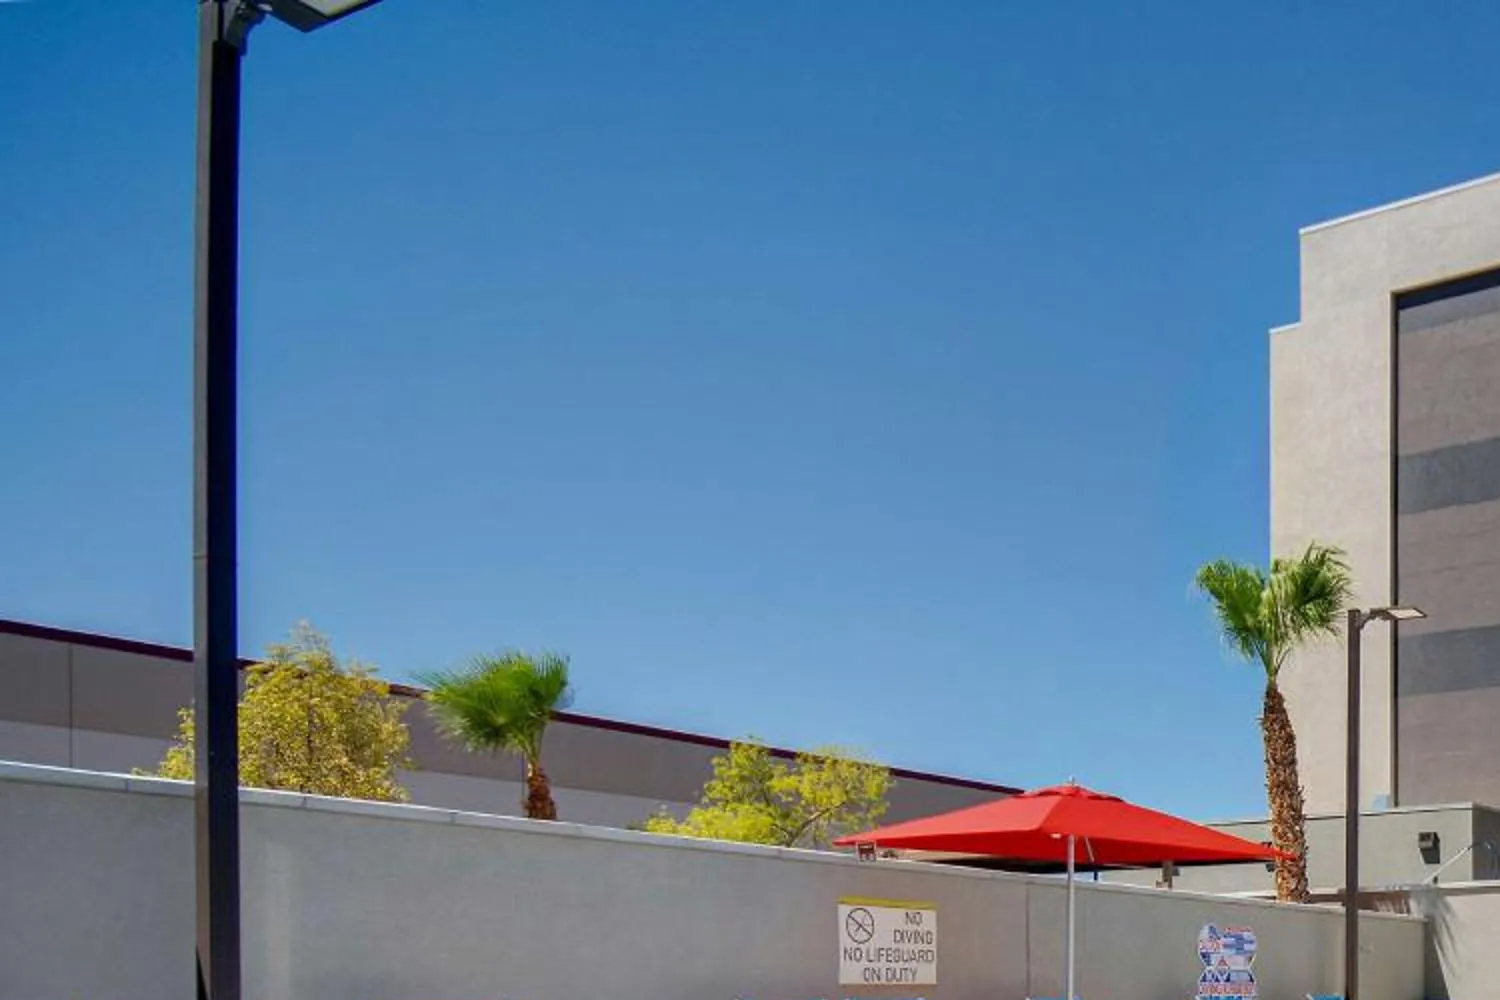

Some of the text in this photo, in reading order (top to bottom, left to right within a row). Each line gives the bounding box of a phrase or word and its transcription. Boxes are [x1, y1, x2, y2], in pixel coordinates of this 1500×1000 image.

[905, 911, 923, 926] NO
[893, 929, 934, 945] DIVING
[843, 947, 935, 963] NO LIFEGUARD
[863, 967, 918, 983] ON DUTY
